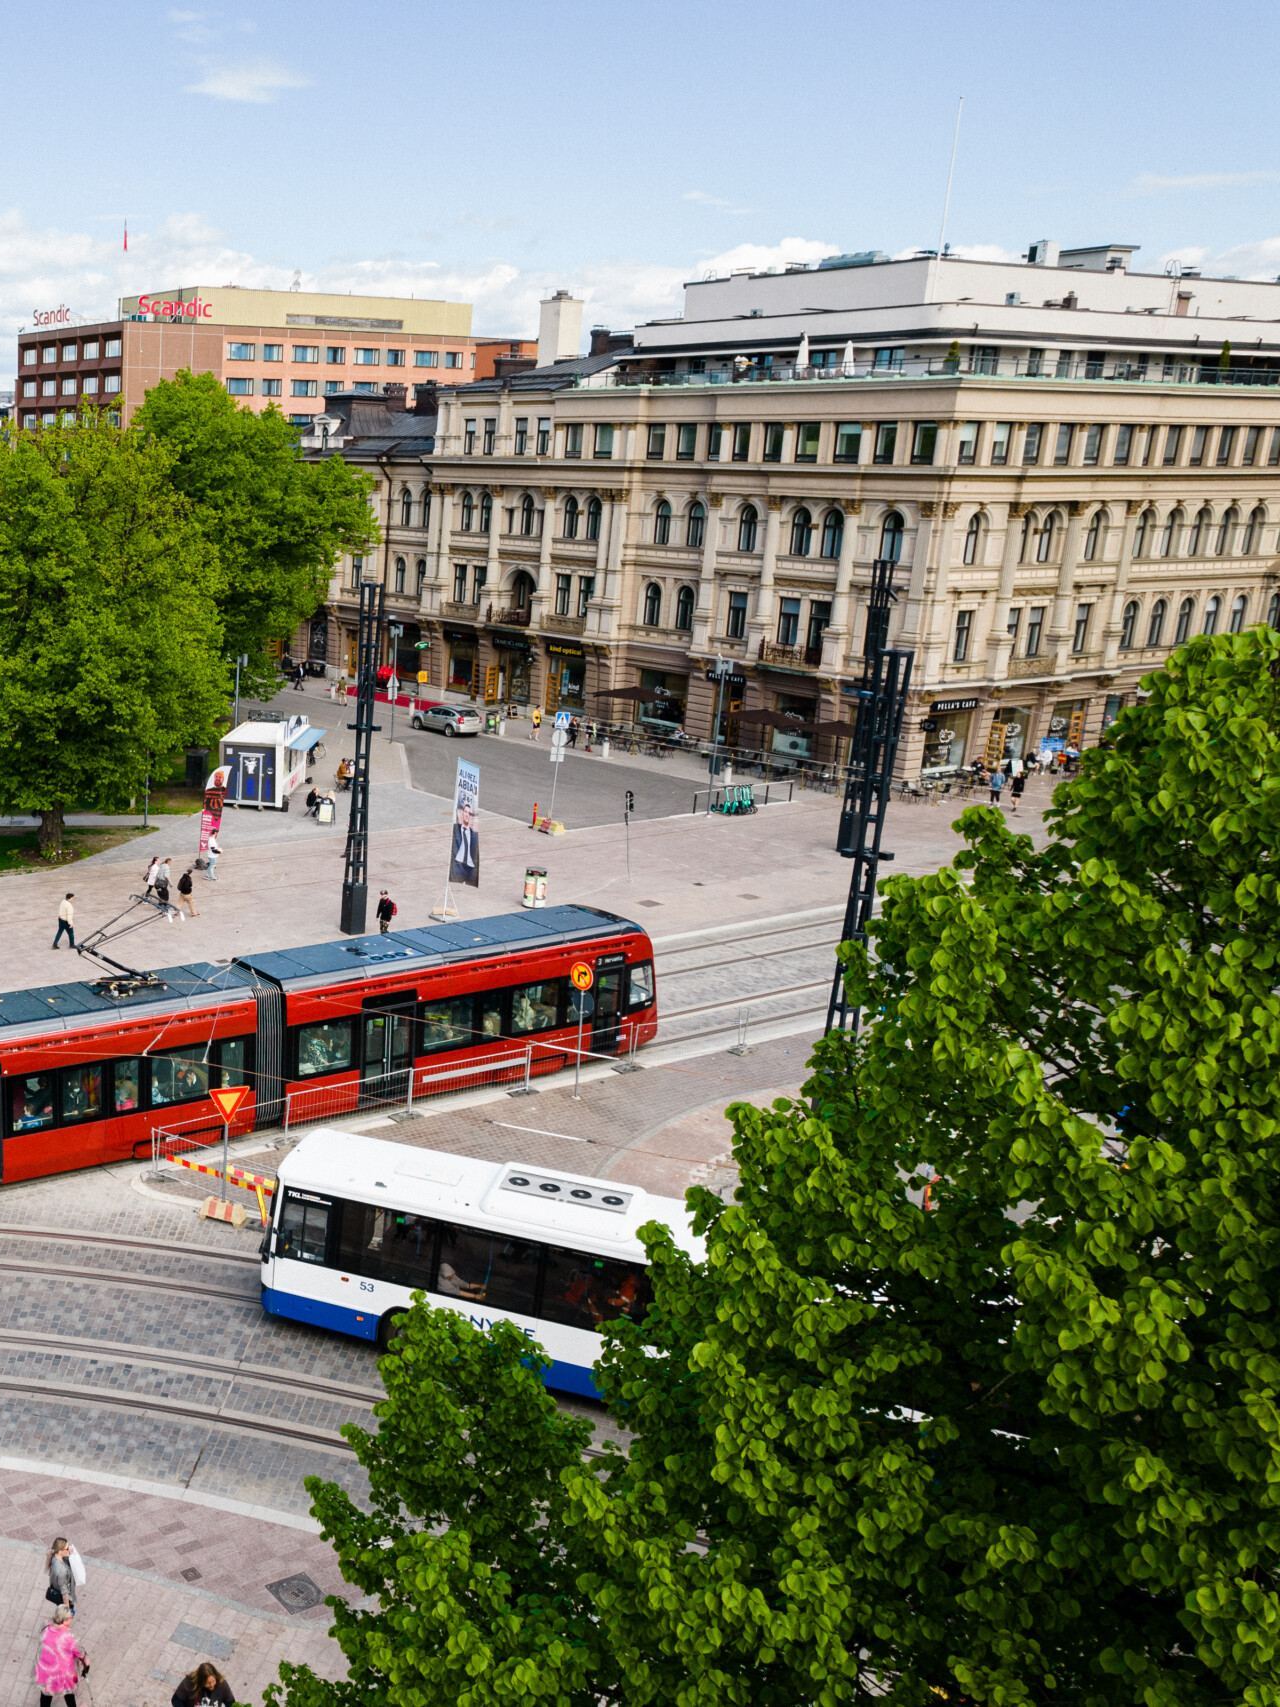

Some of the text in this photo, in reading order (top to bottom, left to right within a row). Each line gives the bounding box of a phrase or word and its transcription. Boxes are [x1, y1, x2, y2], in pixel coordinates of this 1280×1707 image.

[138, 295, 213, 318] Scandic
[33, 304, 71, 326] Scandic
[549, 645, 582, 656] kind optical
[708, 672, 729, 681] PELL'S
[937, 700, 976, 710] PELLA'S CAFE
[288, 1190, 302, 1198] TKL
[359, 1281, 375, 1293] 53
[470, 1314, 536, 1341] NYE
